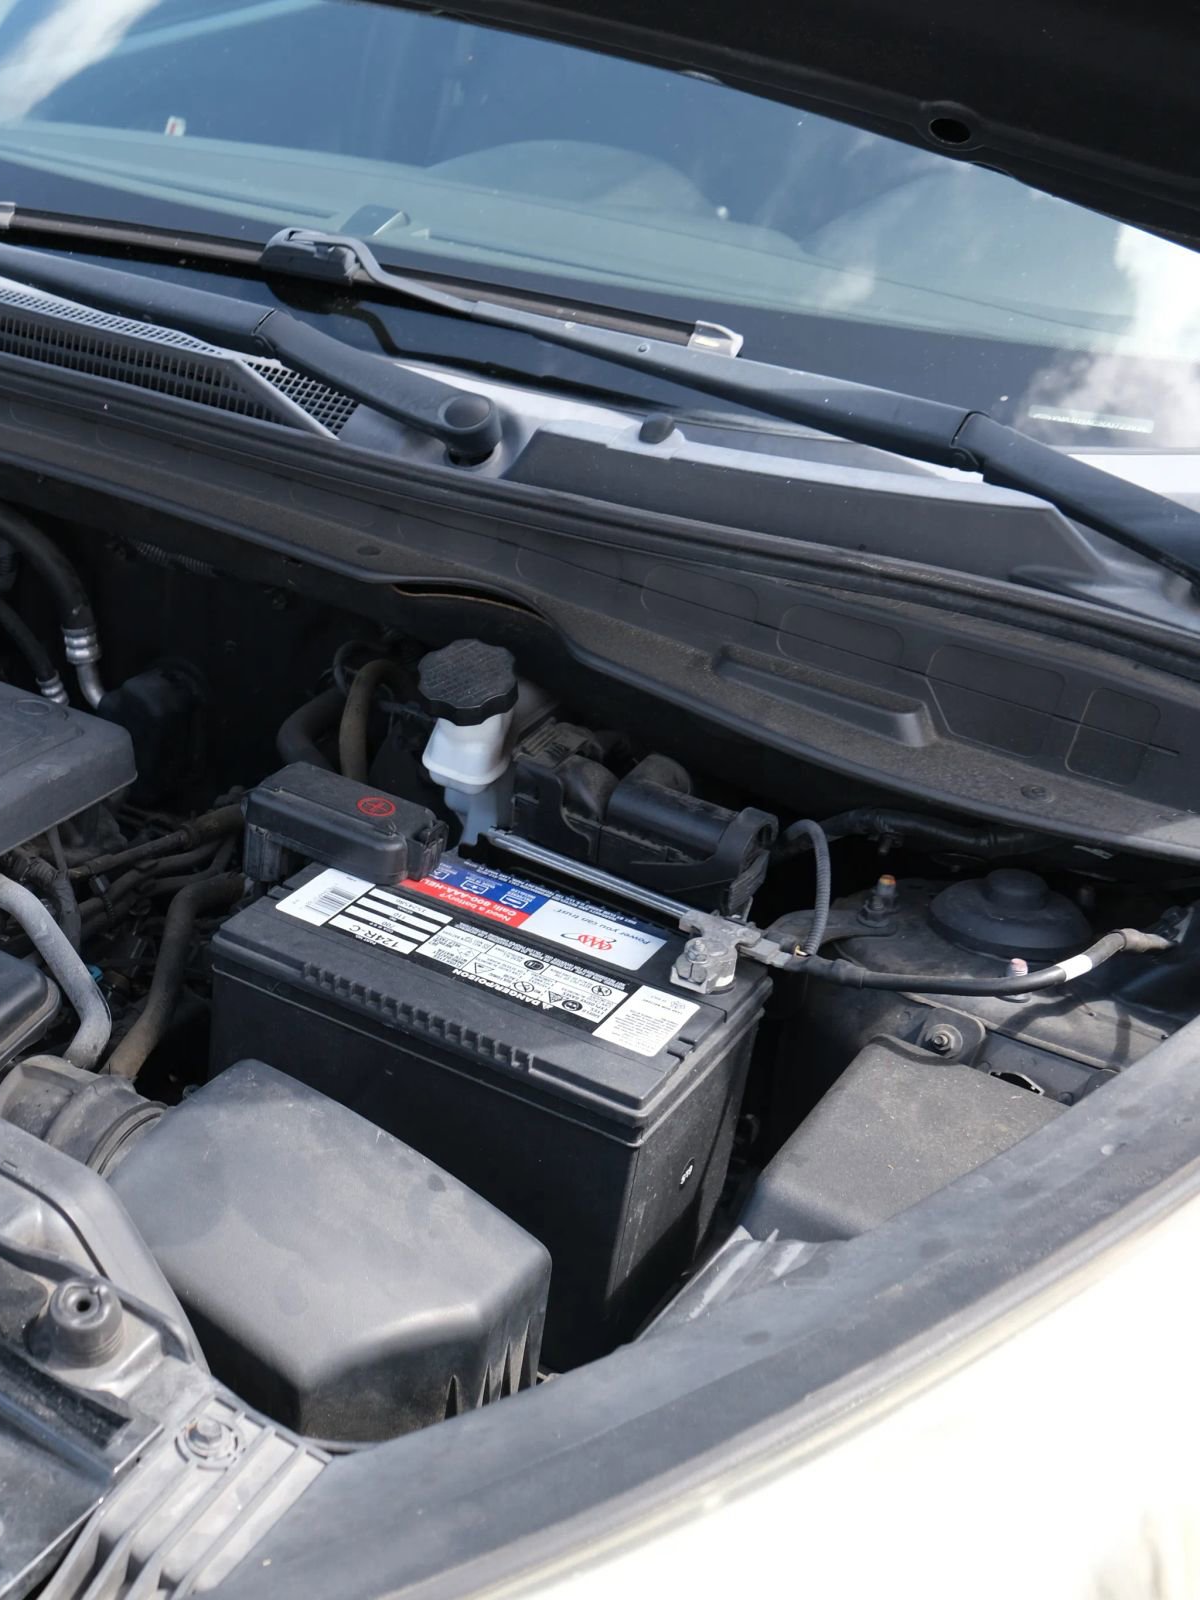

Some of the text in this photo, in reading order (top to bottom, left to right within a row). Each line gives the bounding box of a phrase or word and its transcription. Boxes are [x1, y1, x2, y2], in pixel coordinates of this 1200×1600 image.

[417, 877, 492, 907] 800-AAA-HEL
[437, 891, 478, 909] battery?
[484, 908, 512, 921] Need
[492, 904, 517, 916] Call:
[347, 924, 401, 948] 124R-C
[556, 908, 650, 944] Power you can trust
[577, 934, 612, 951] AAA
[451, 968, 541, 1005] DANGER/POISON
